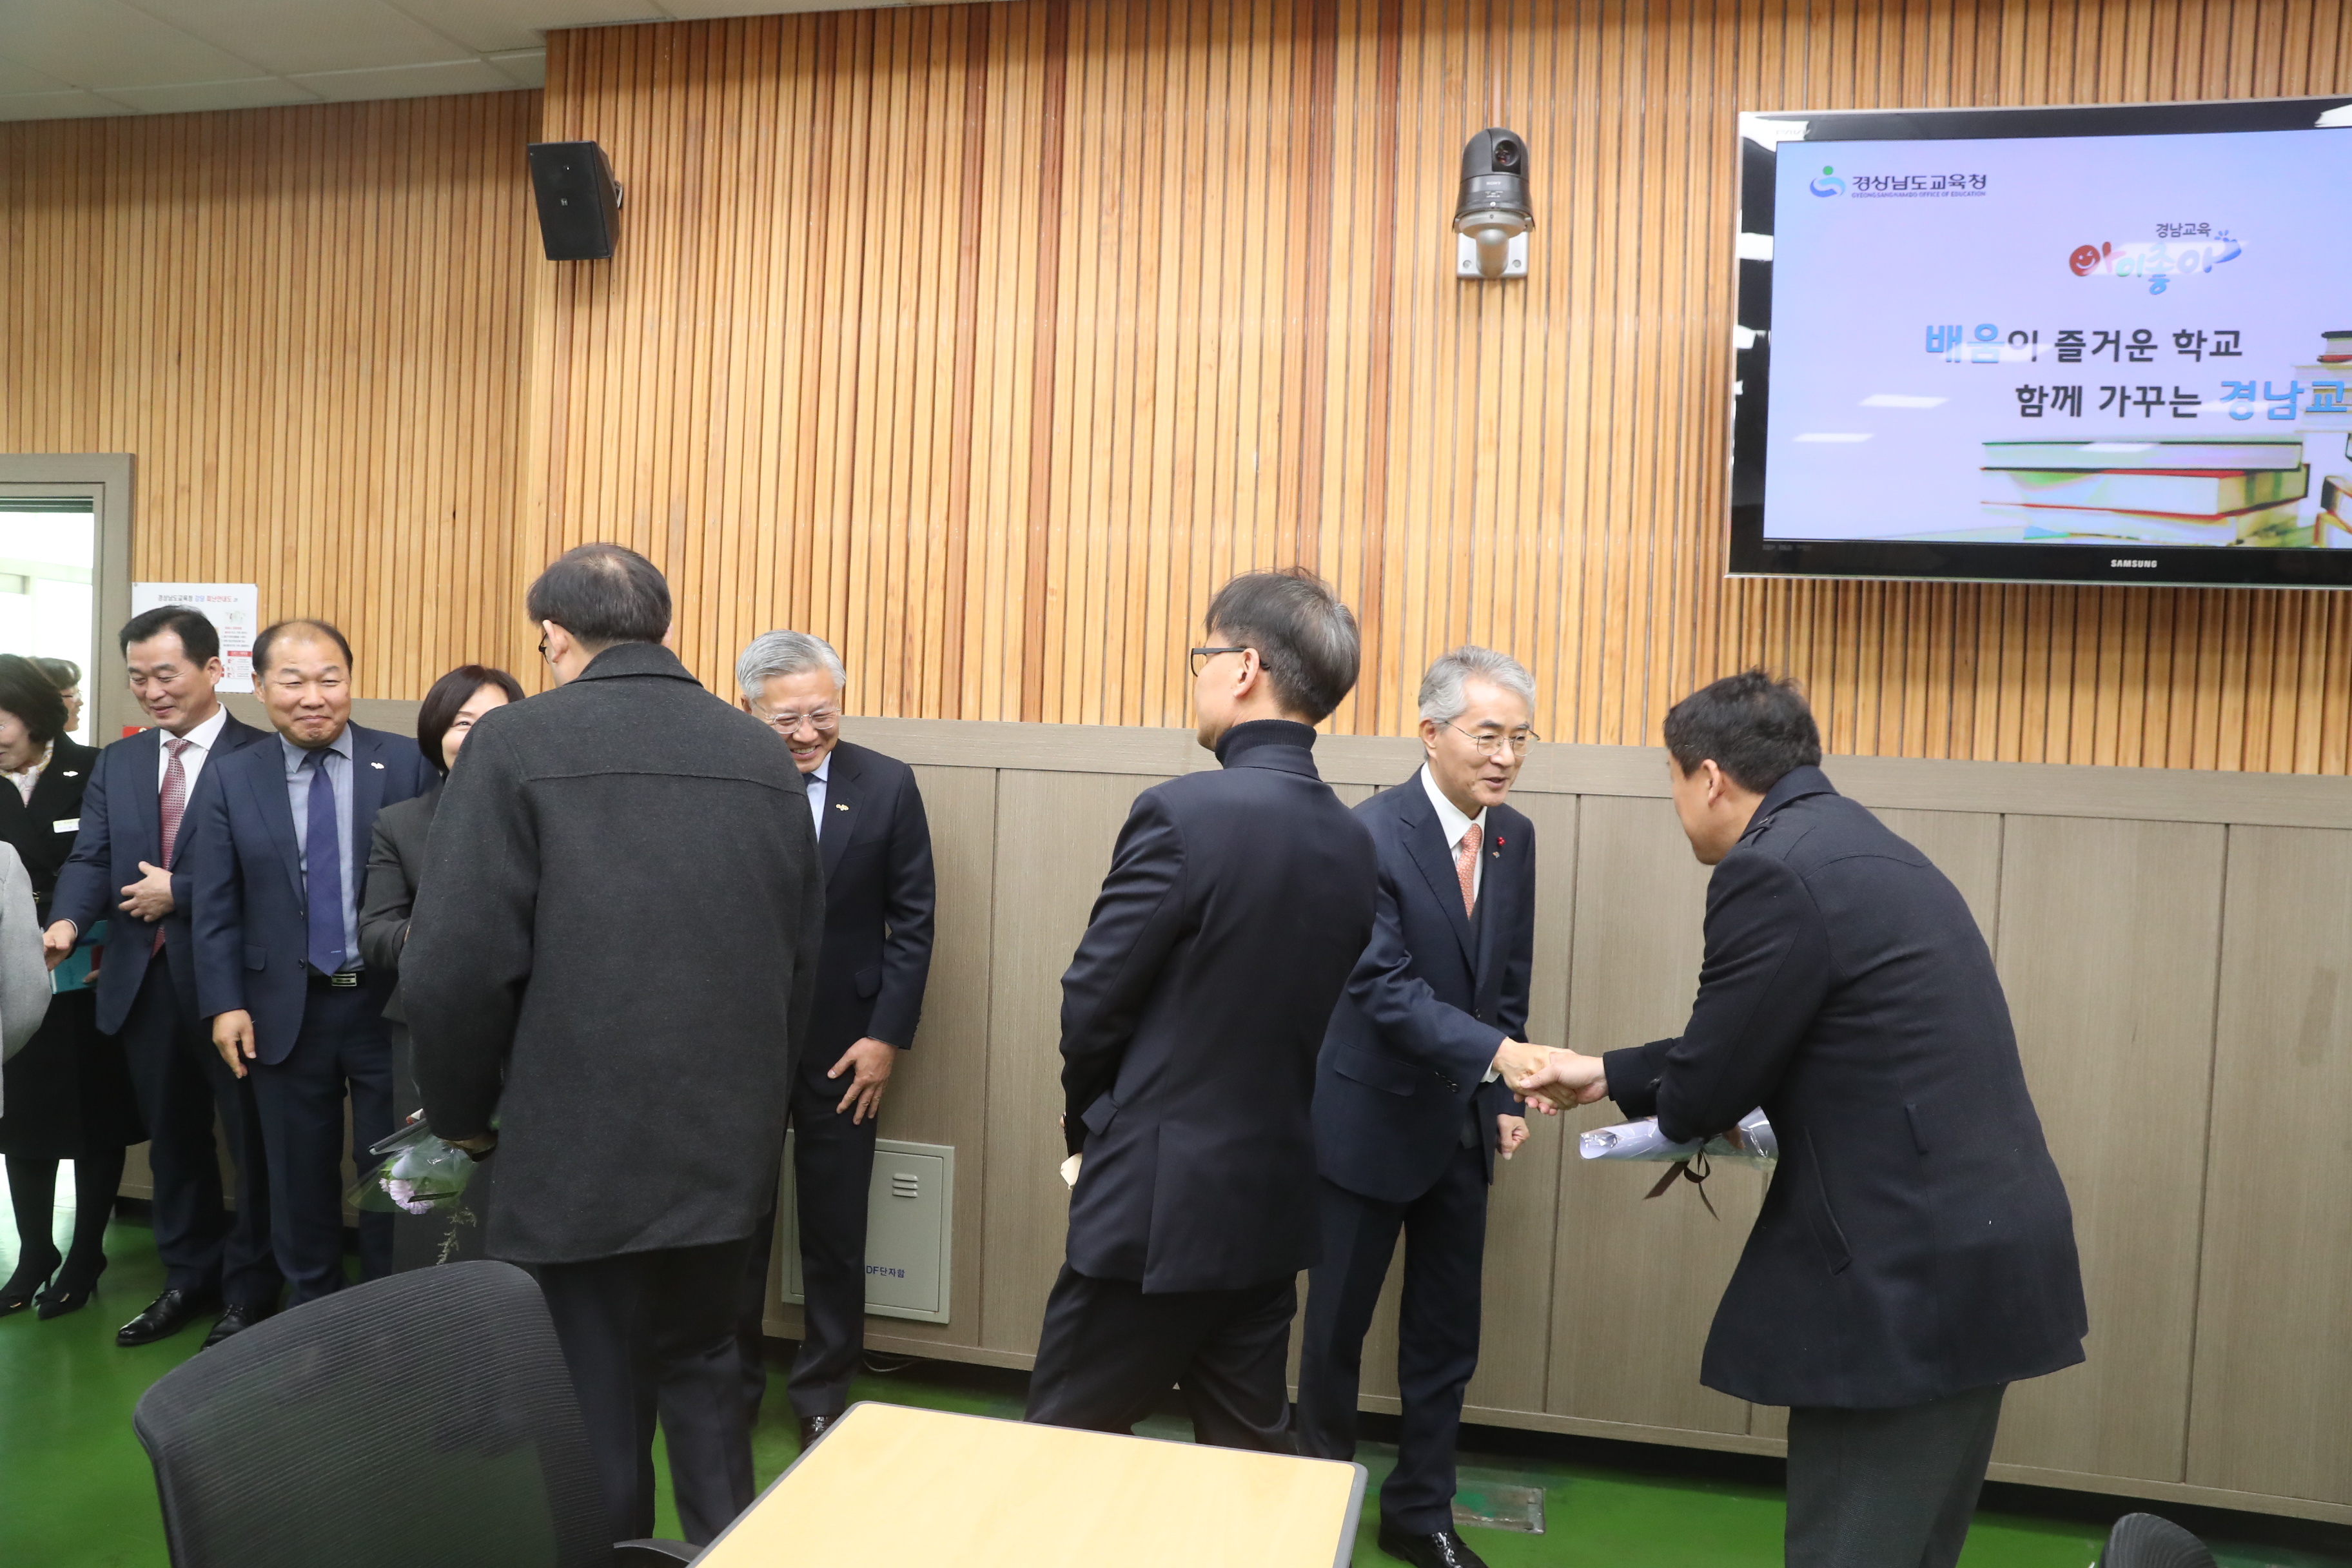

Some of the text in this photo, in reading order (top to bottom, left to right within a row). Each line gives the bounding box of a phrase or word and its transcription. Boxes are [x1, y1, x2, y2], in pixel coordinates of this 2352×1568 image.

[1852, 173, 1987, 191] 경상남도교육청
[2155, 222, 2211, 238] 경남교육
[2068, 240, 2242, 295] 아이좋아
[1926, 323, 2243, 364] 배움이 즐거운 학교
[2015, 384, 2083, 418] 함께
[2098, 385, 2203, 418] 가꾸는
[2110, 559, 2158, 568] SAMSUNG
[866, 1266, 905, 1278] DF단자함
